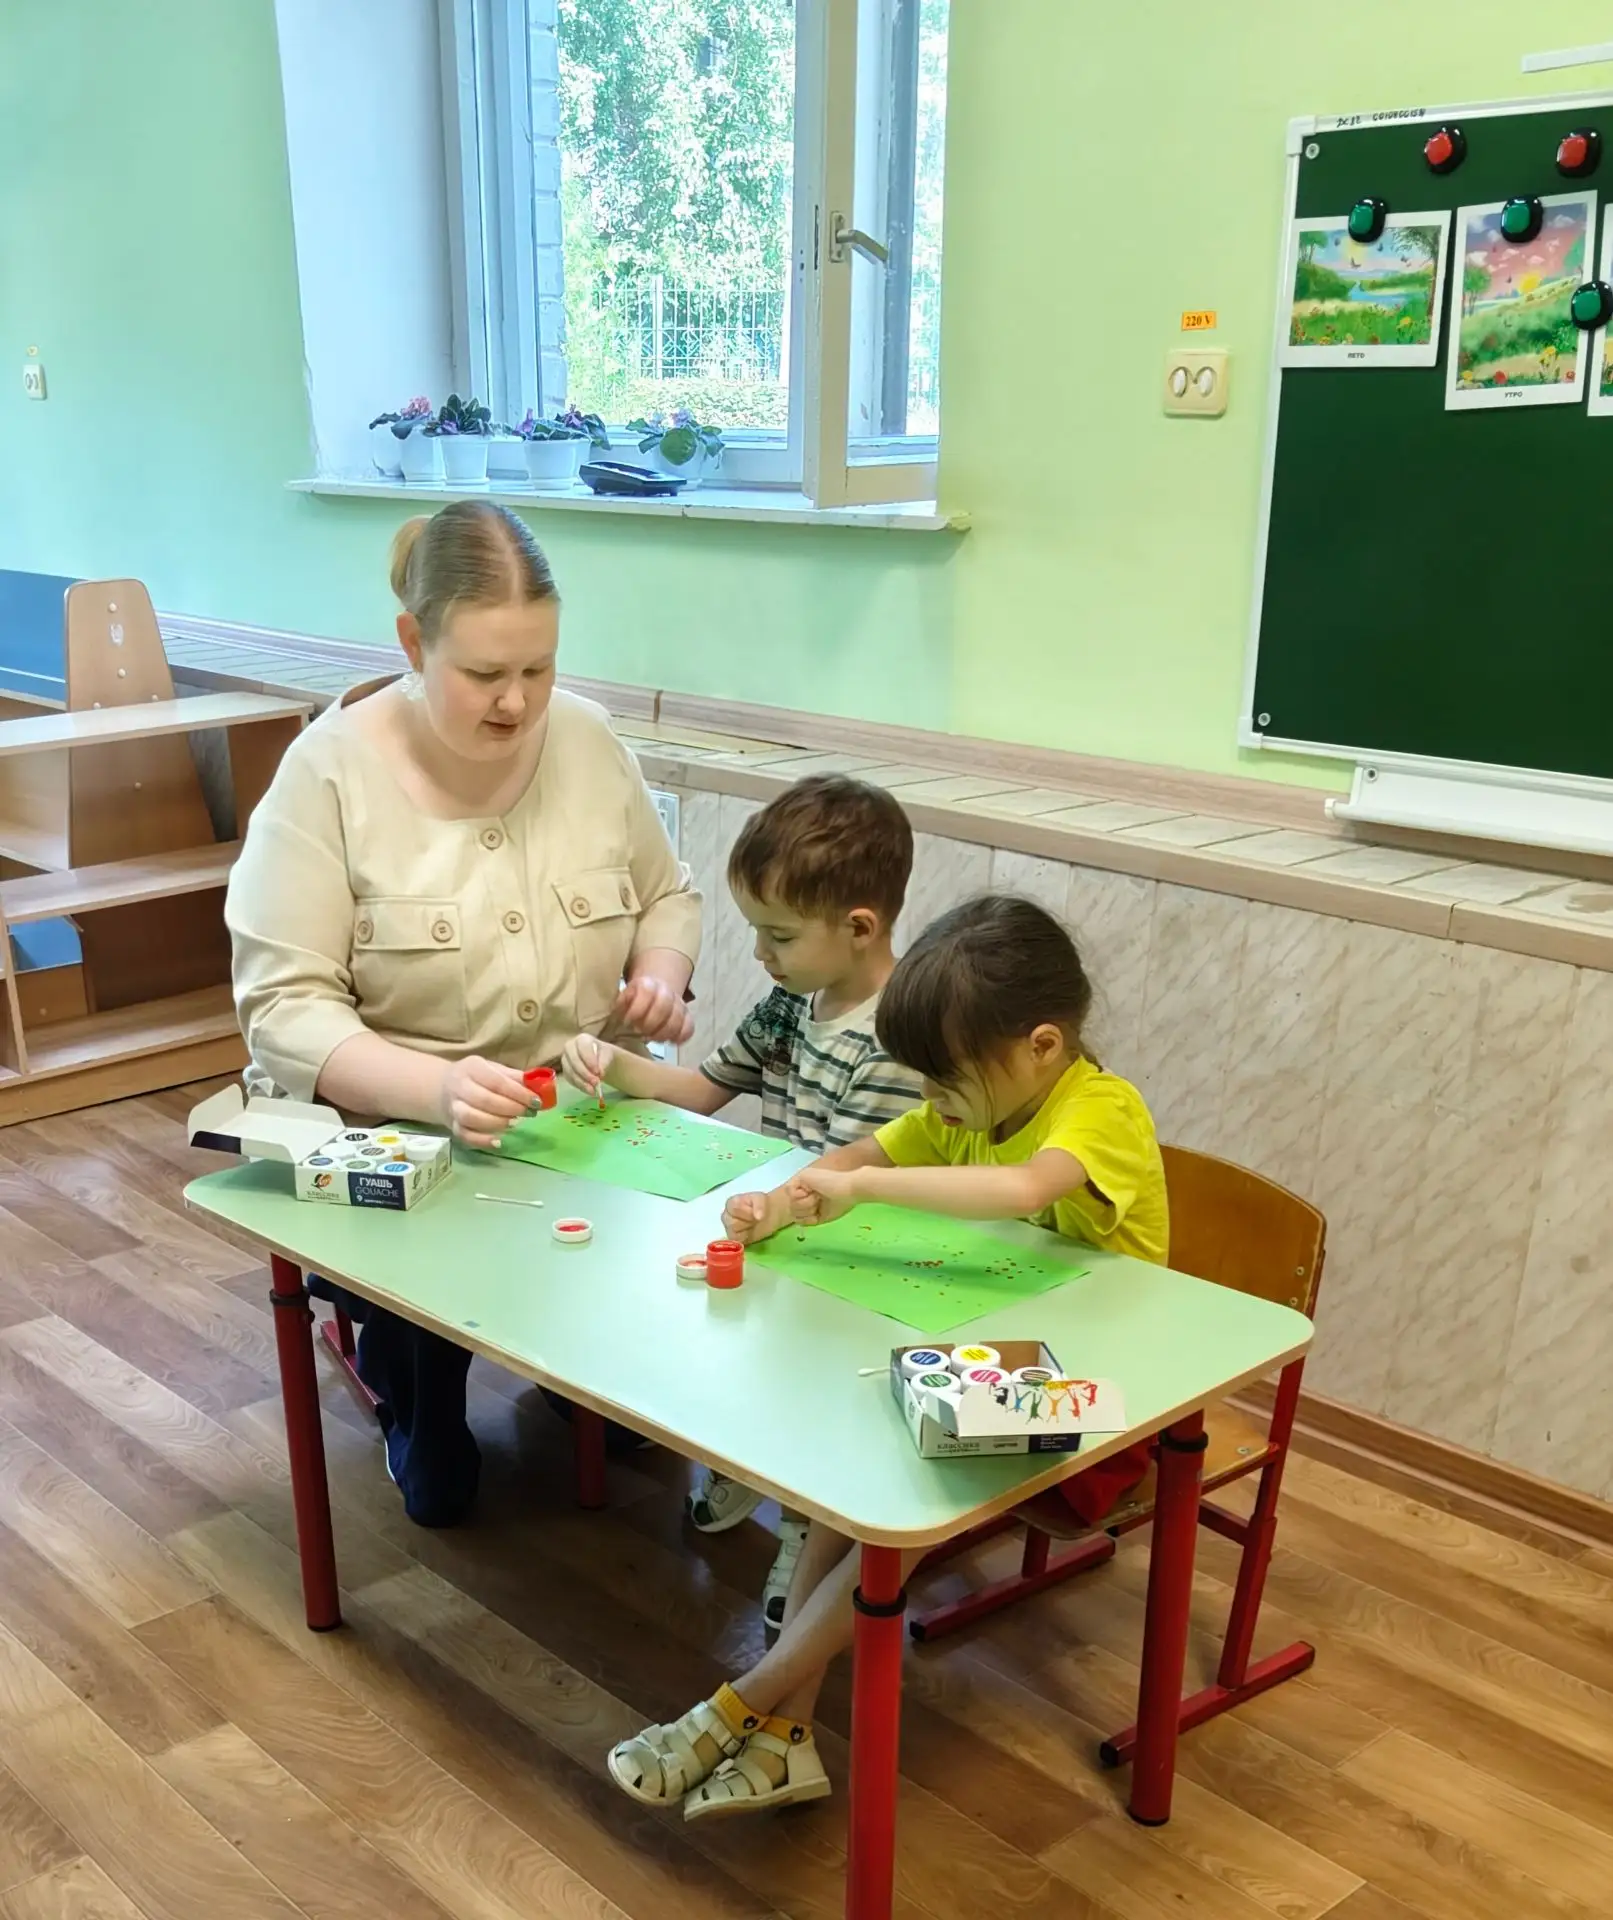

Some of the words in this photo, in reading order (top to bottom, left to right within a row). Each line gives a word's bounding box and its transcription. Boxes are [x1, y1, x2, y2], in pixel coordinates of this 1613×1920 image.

[1186, 315, 1203, 326] 220
[1204, 314, 1213, 325] V
[1504, 391, 1524, 399] УТРО
[359, 1177, 393, 1189] ГУАШЬ
[355, 1186, 400, 1198] GOUACHE
